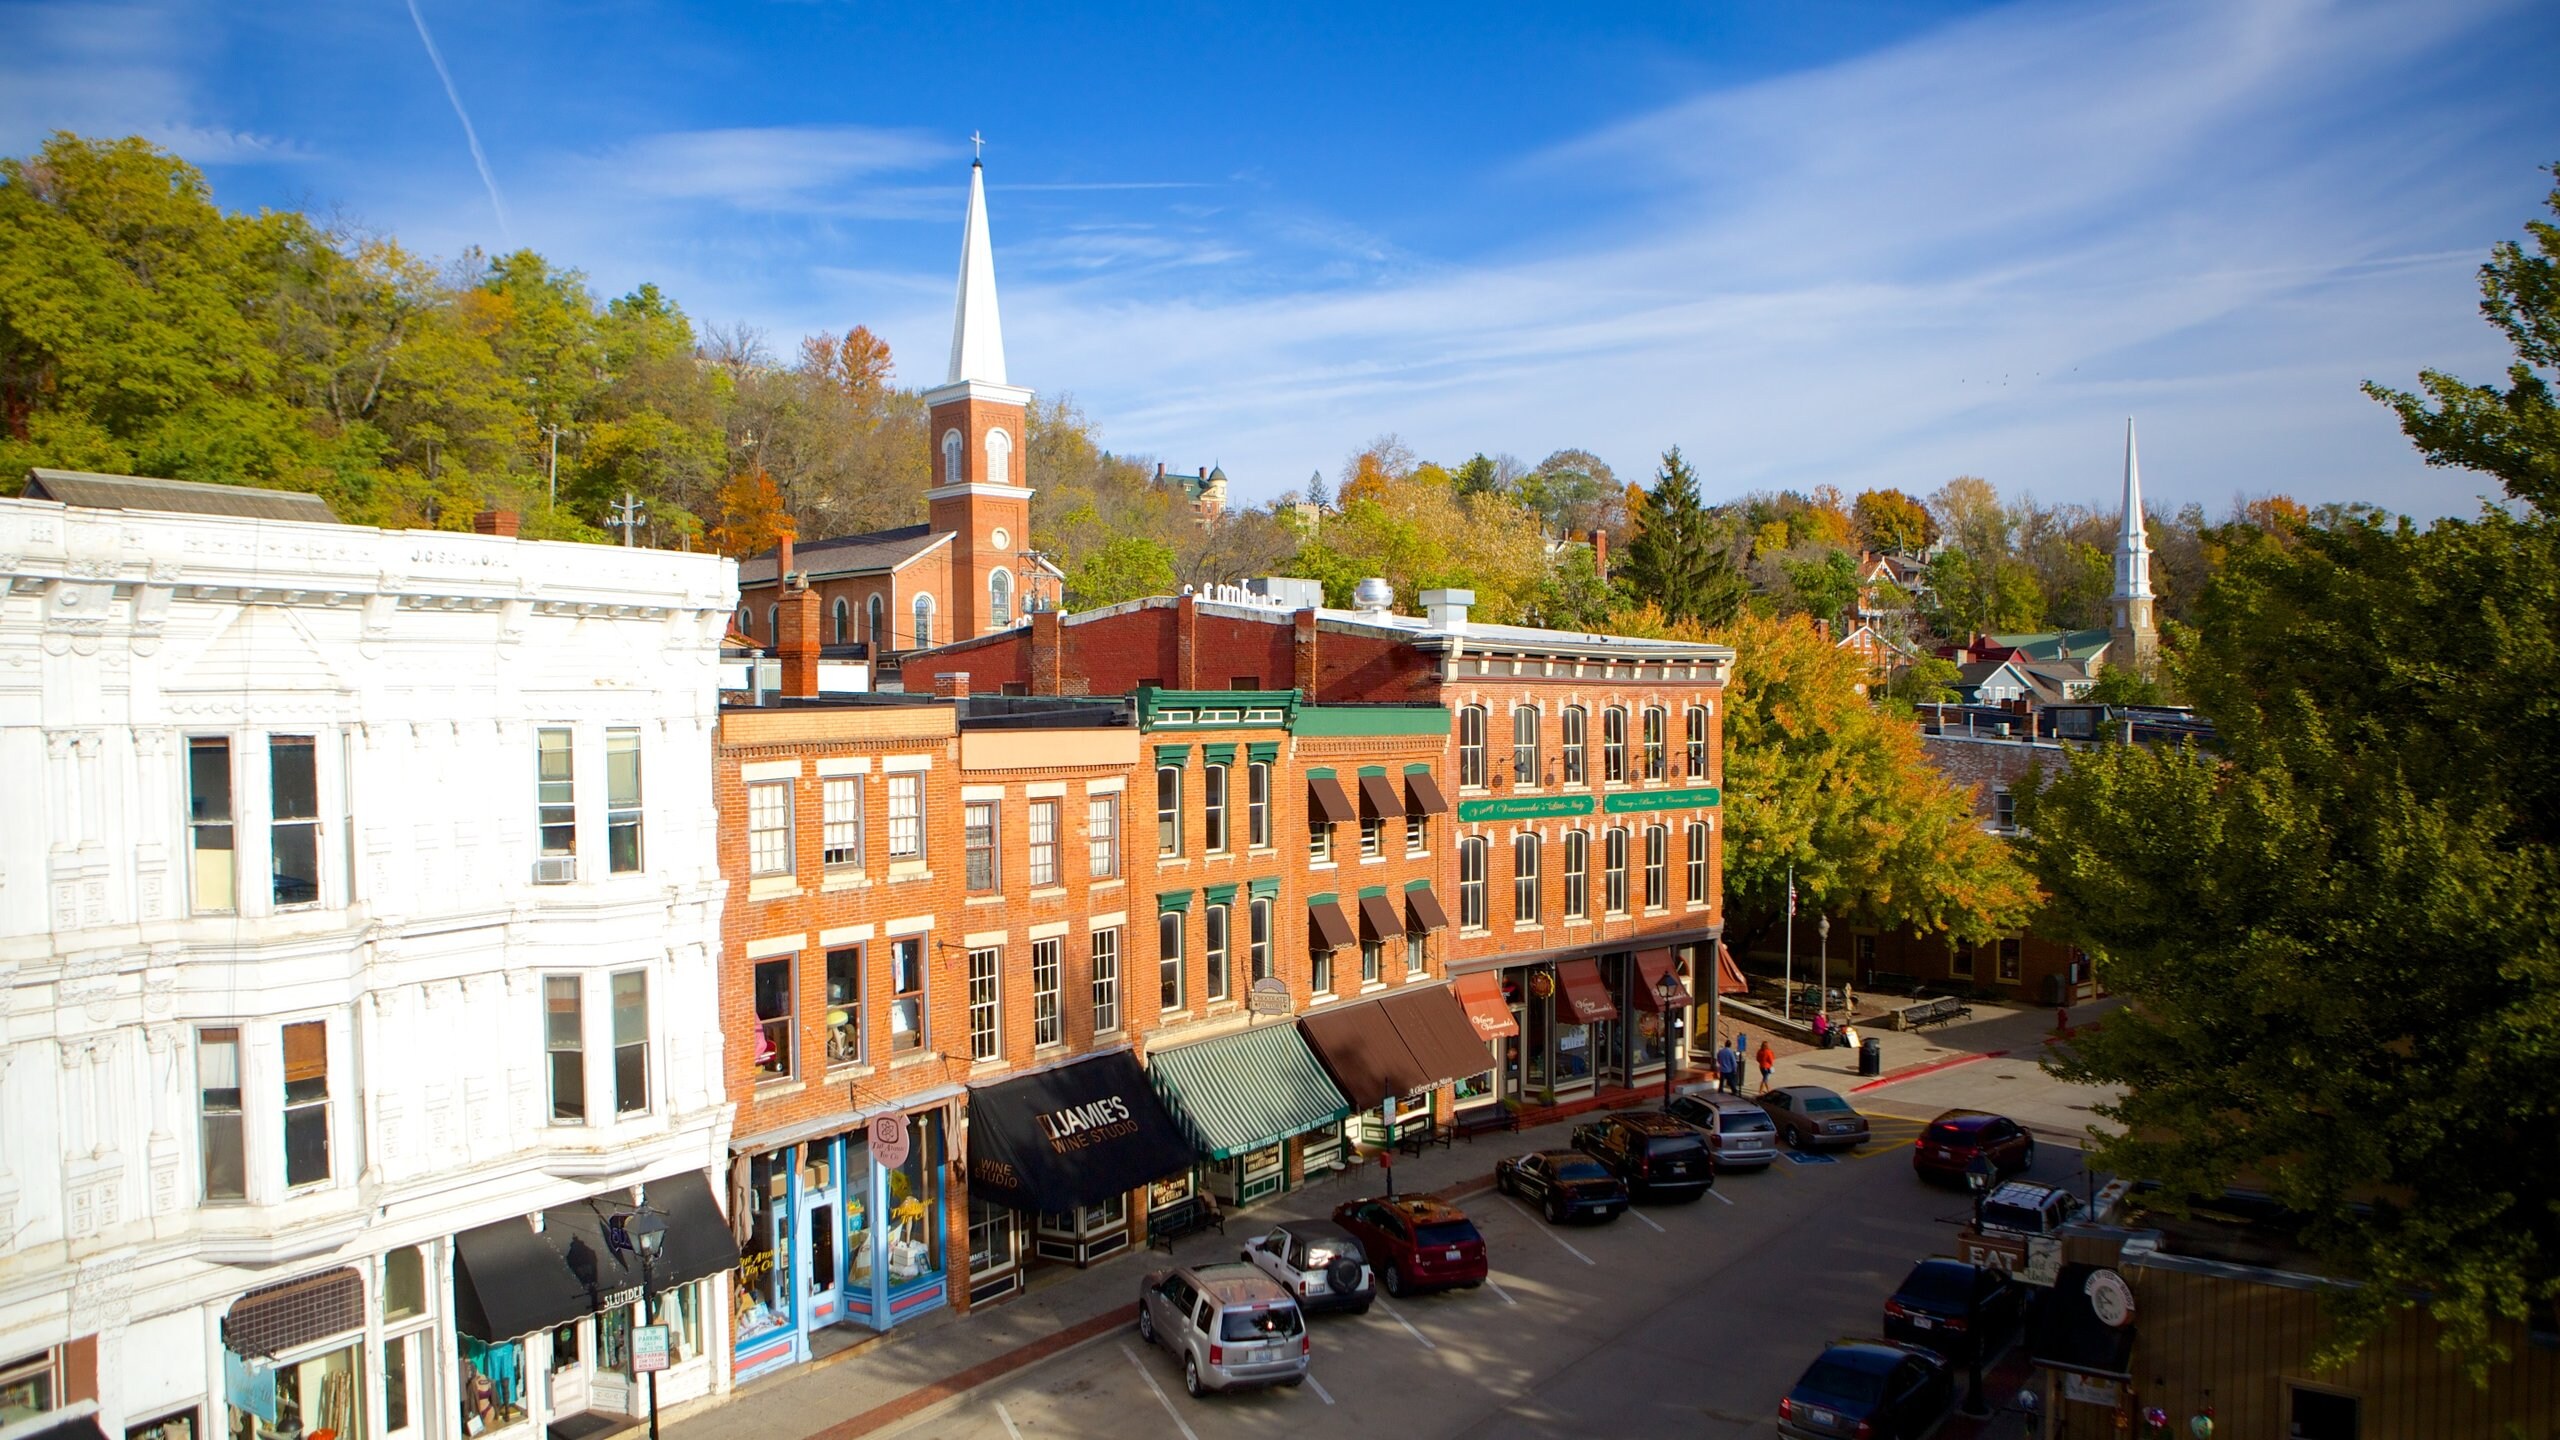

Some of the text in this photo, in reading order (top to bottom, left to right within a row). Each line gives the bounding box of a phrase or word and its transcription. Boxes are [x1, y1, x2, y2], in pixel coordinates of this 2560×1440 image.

[1056, 1095, 1130, 1137] JAMIE'S
[1051, 1119, 1139, 1154] WINE STUDIO
[1229, 1112, 1335, 1155] ROCKY MOUNTAIN CHOCOLATE FACTORY
[974, 1167, 1018, 1189] STUDIO
[981, 1157, 1013, 1176] WINE
[1969, 1245, 2018, 1271] EAT
